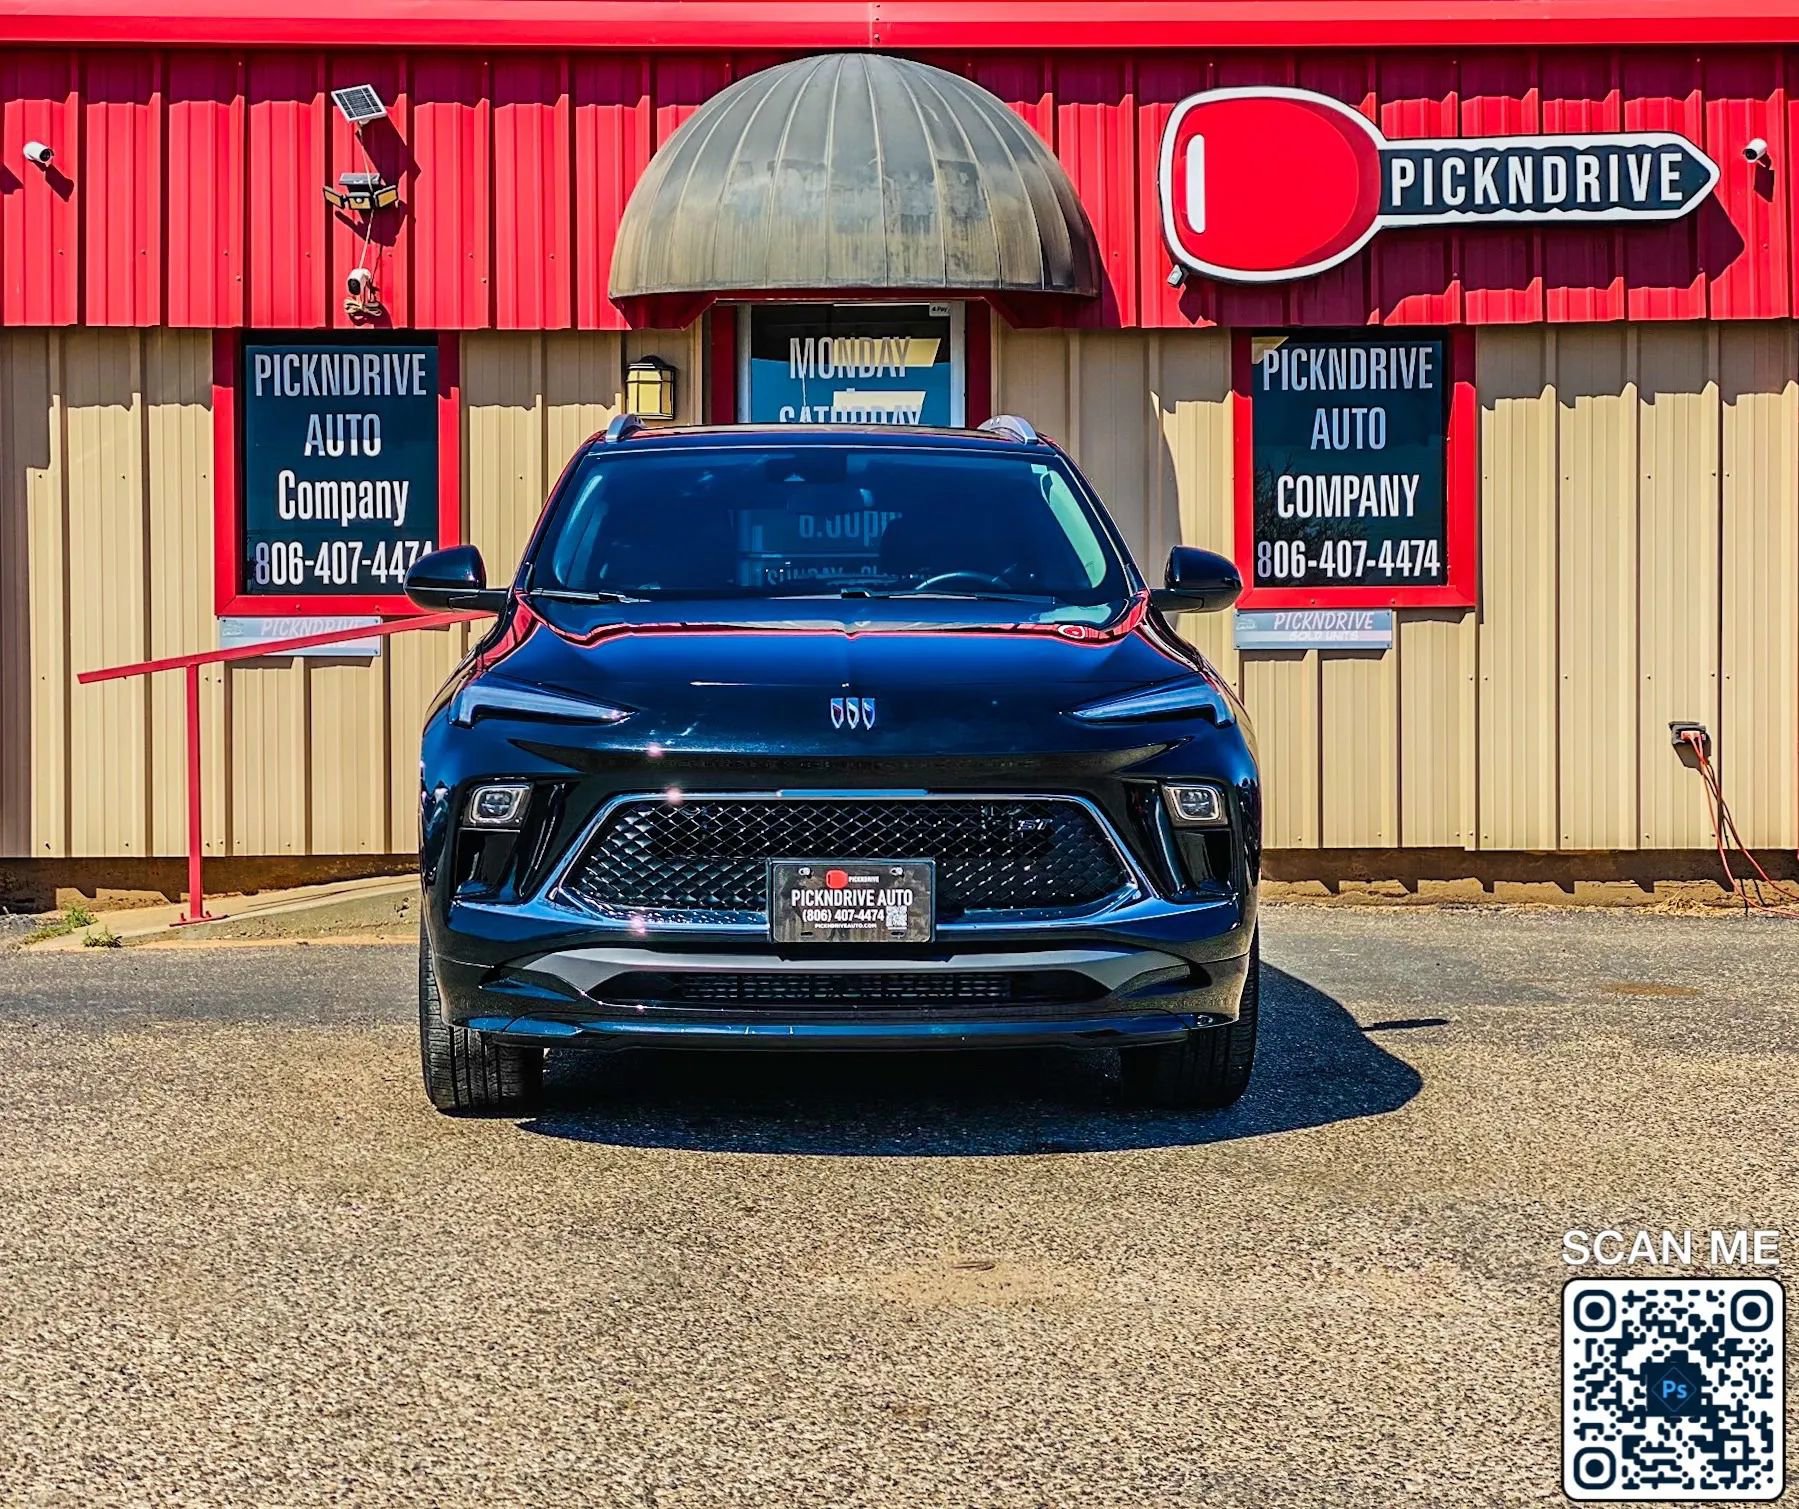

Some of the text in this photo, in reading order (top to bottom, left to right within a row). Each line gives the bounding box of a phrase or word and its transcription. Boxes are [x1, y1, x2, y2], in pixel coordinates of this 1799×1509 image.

[1391, 152, 1683, 208] PICKNDRIVE
[254, 353, 427, 397] PICKNDRIVE
[789, 336, 912, 380] MONDAY
[1262, 347, 1434, 392] PICKNDRIVE
[303, 413, 382, 458] AUTO
[1310, 407, 1387, 451] AUTO
[277, 469, 409, 526] Company
[1276, 474, 1419, 518] COMPANY
[1257, 538, 1440, 578] 806-407-4474
[1273, 611, 1375, 630] PICKNDRIVE
[791, 888, 914, 907] PICKNDRIVE AUTO
[802, 908, 885, 923] (806) 407-4474
